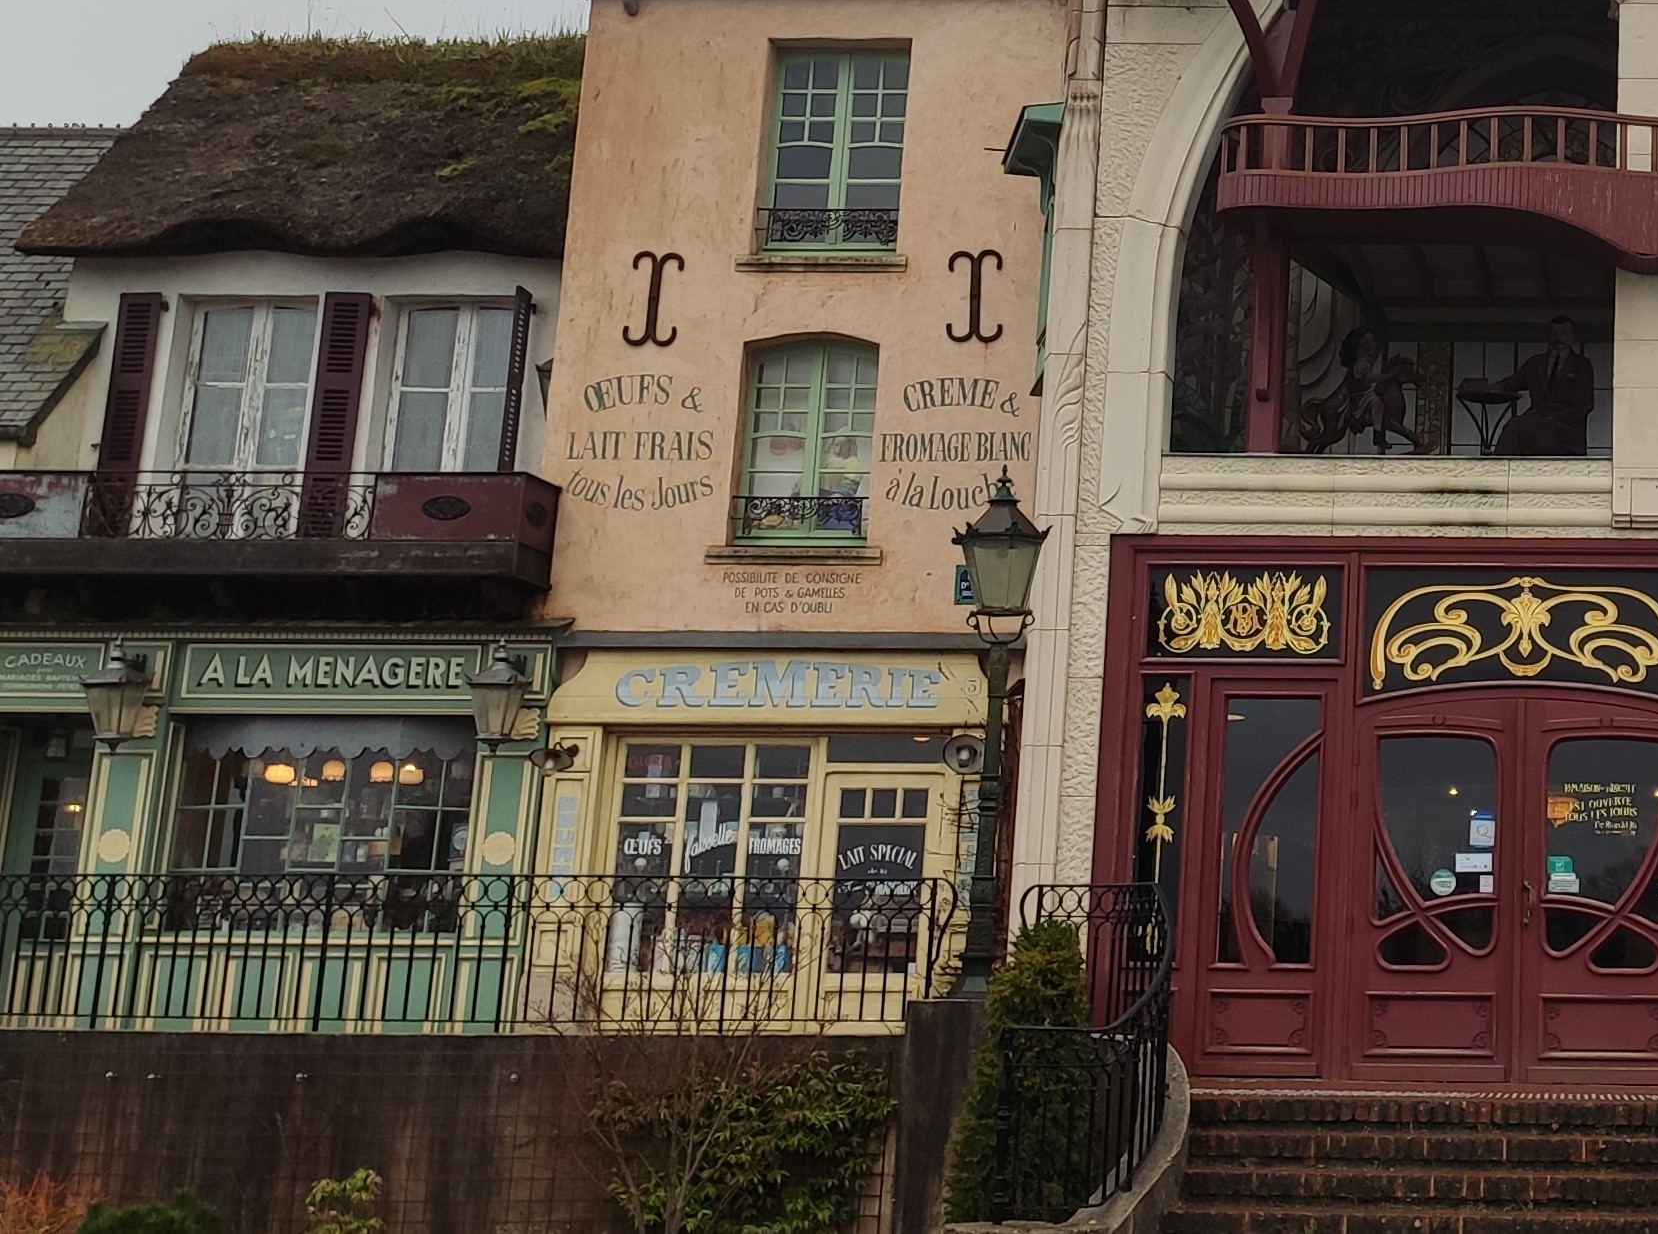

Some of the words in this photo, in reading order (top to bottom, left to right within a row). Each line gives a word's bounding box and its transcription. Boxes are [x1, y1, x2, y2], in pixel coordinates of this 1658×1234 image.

[584, 374, 673, 413] ŒUFS
[681, 386, 702, 413] &
[903, 377, 1000, 412] CREME
[1000, 392, 1020, 417] &
[566, 431, 626, 460] LAIT
[633, 430, 713, 460] FRAIS
[879, 432, 972, 462] FROMAGE
[975, 431, 1032, 462] BLANC
[566, 467, 611, 506] tous
[613, 474, 645, 511] les
[651, 475, 714, 510] Jours
[885, 467, 902, 502] à
[902, 472, 924, 508] la
[926, 472, 1016, 510] Louch
[723, 572, 778, 584] POSSIBILITE
[785, 573, 798, 584] DE
[806, 573, 862, 584] CONSIGNE
[735, 587, 746, 598] DE
[755, 587, 779, 598] POTS
[797, 588, 846, 599] GAMELLES
[746, 602, 759, 613] EN
[764, 602, 784, 613] CAS
[791, 601, 833, 614] D'OUBLI
[4, 653, 87, 669] CADEAUX
[197, 652, 226, 687] A
[235, 653, 274, 688] LA
[287, 654, 466, 690] MENAGERE
[615, 660, 941, 709] CREMERIE
[624, 838, 663, 856] ŒUFS
[748, 837, 801, 855] FROMAGES
[838, 846, 865, 871] LAIT
[870, 844, 918, 870] SPECIAL
